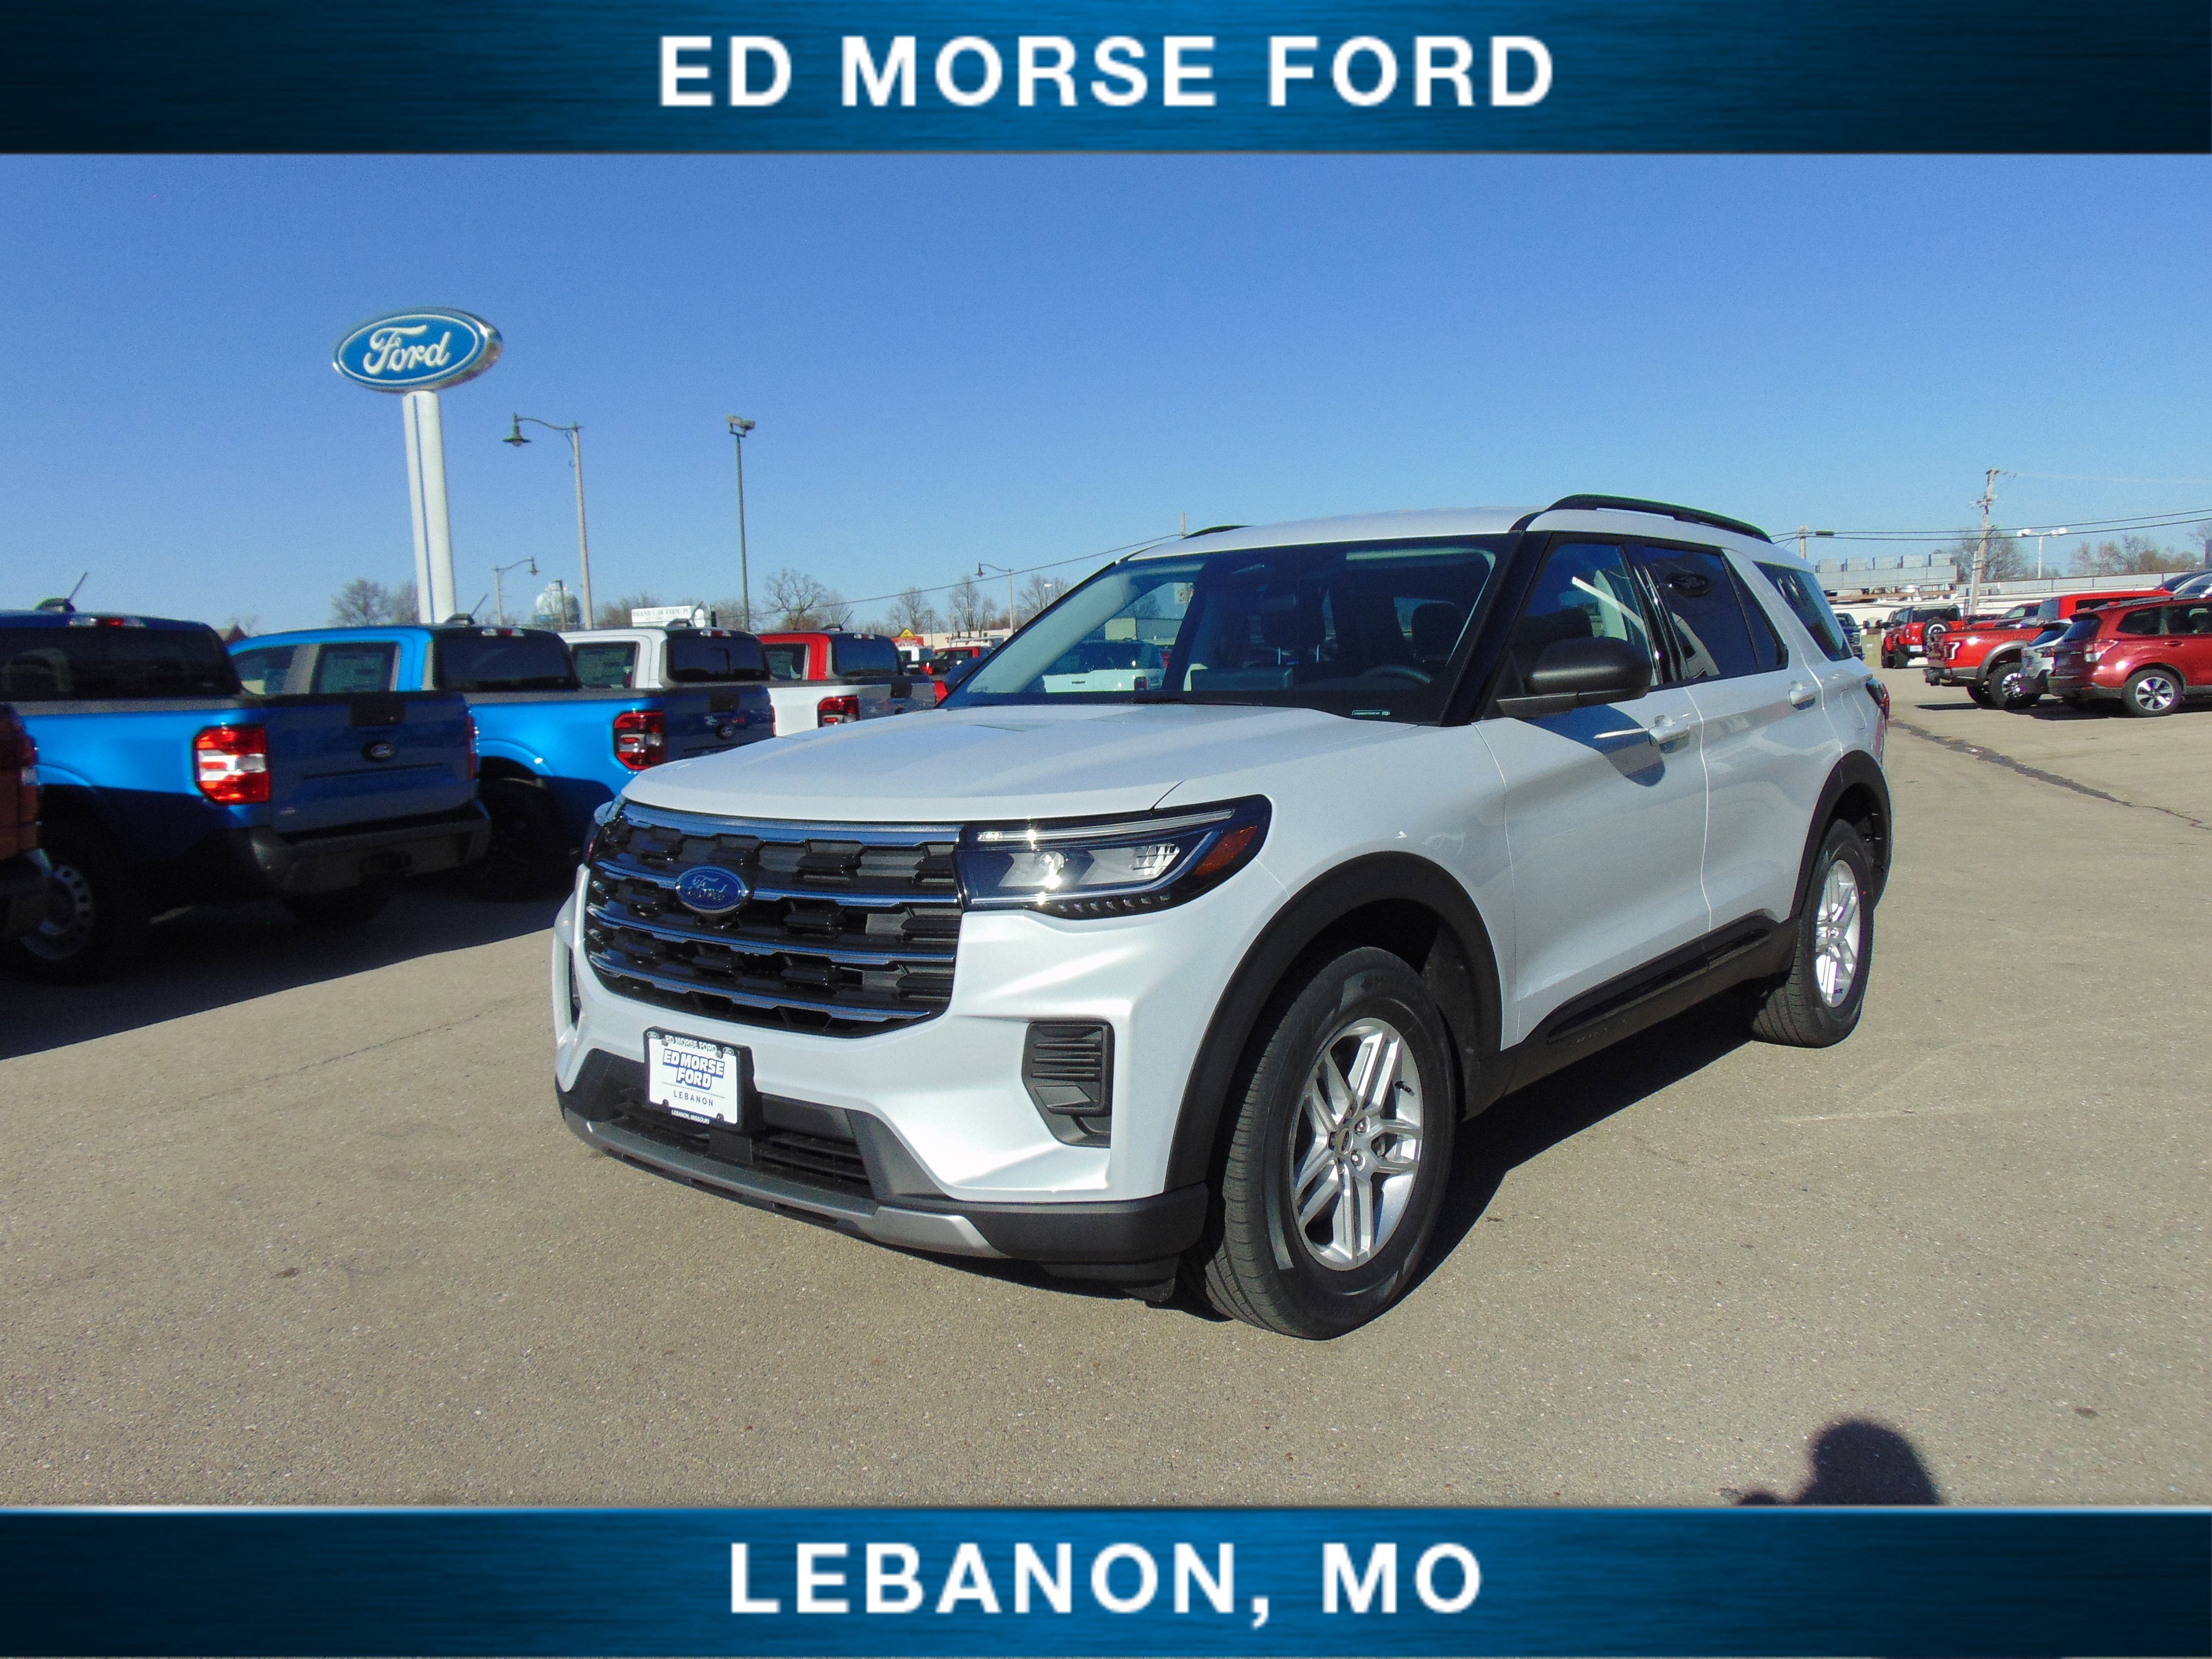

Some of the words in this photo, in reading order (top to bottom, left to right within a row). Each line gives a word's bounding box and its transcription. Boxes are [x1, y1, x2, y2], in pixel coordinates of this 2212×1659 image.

[363, 325, 451, 375] Ford
[688, 875, 728, 901] Ford
[665, 1034, 675, 1044] ED
[675, 1037, 699, 1049] MORSE
[699, 1042, 717, 1053] FORD
[663, 1049, 680, 1066] ED
[680, 1053, 725, 1077] MORSE
[676, 1067, 711, 1089] FORD
[674, 1090, 713, 1106] LEBANON
